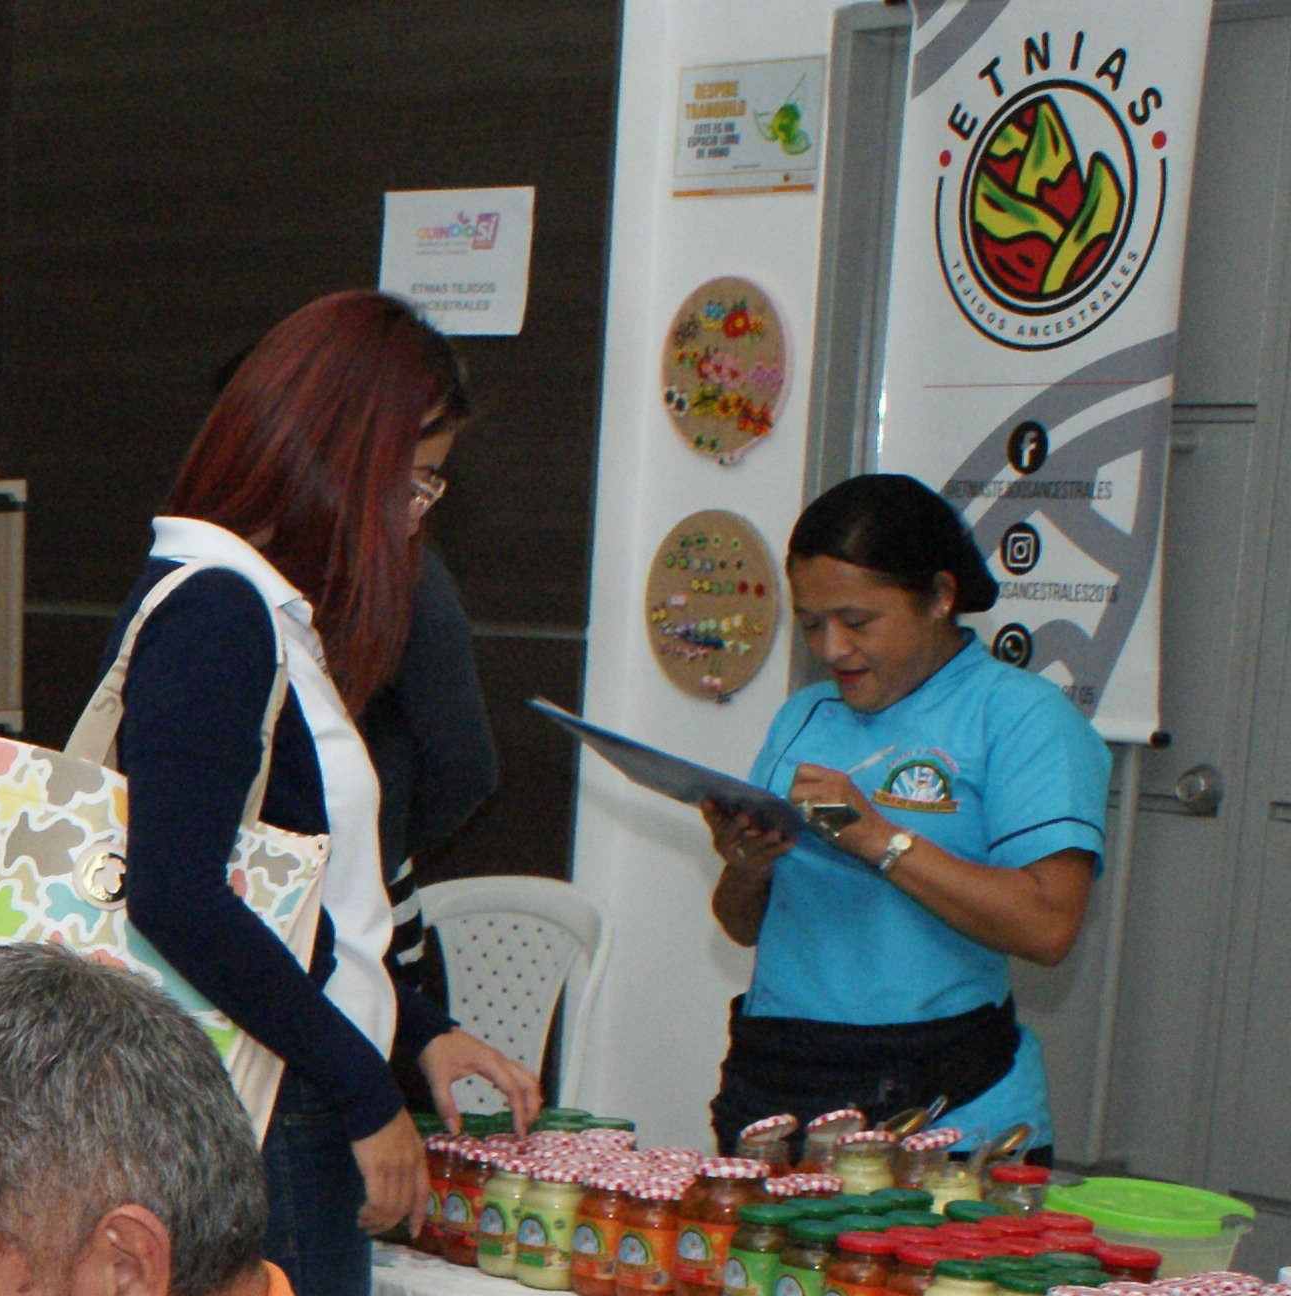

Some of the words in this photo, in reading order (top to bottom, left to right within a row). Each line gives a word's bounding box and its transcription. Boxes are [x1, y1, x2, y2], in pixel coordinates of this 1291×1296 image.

[947, 29, 1163, 142] ETNIAS
[951, 259, 1007, 331] TEJIDOS
[1015, 249, 1139, 338] ANCESTRALES
